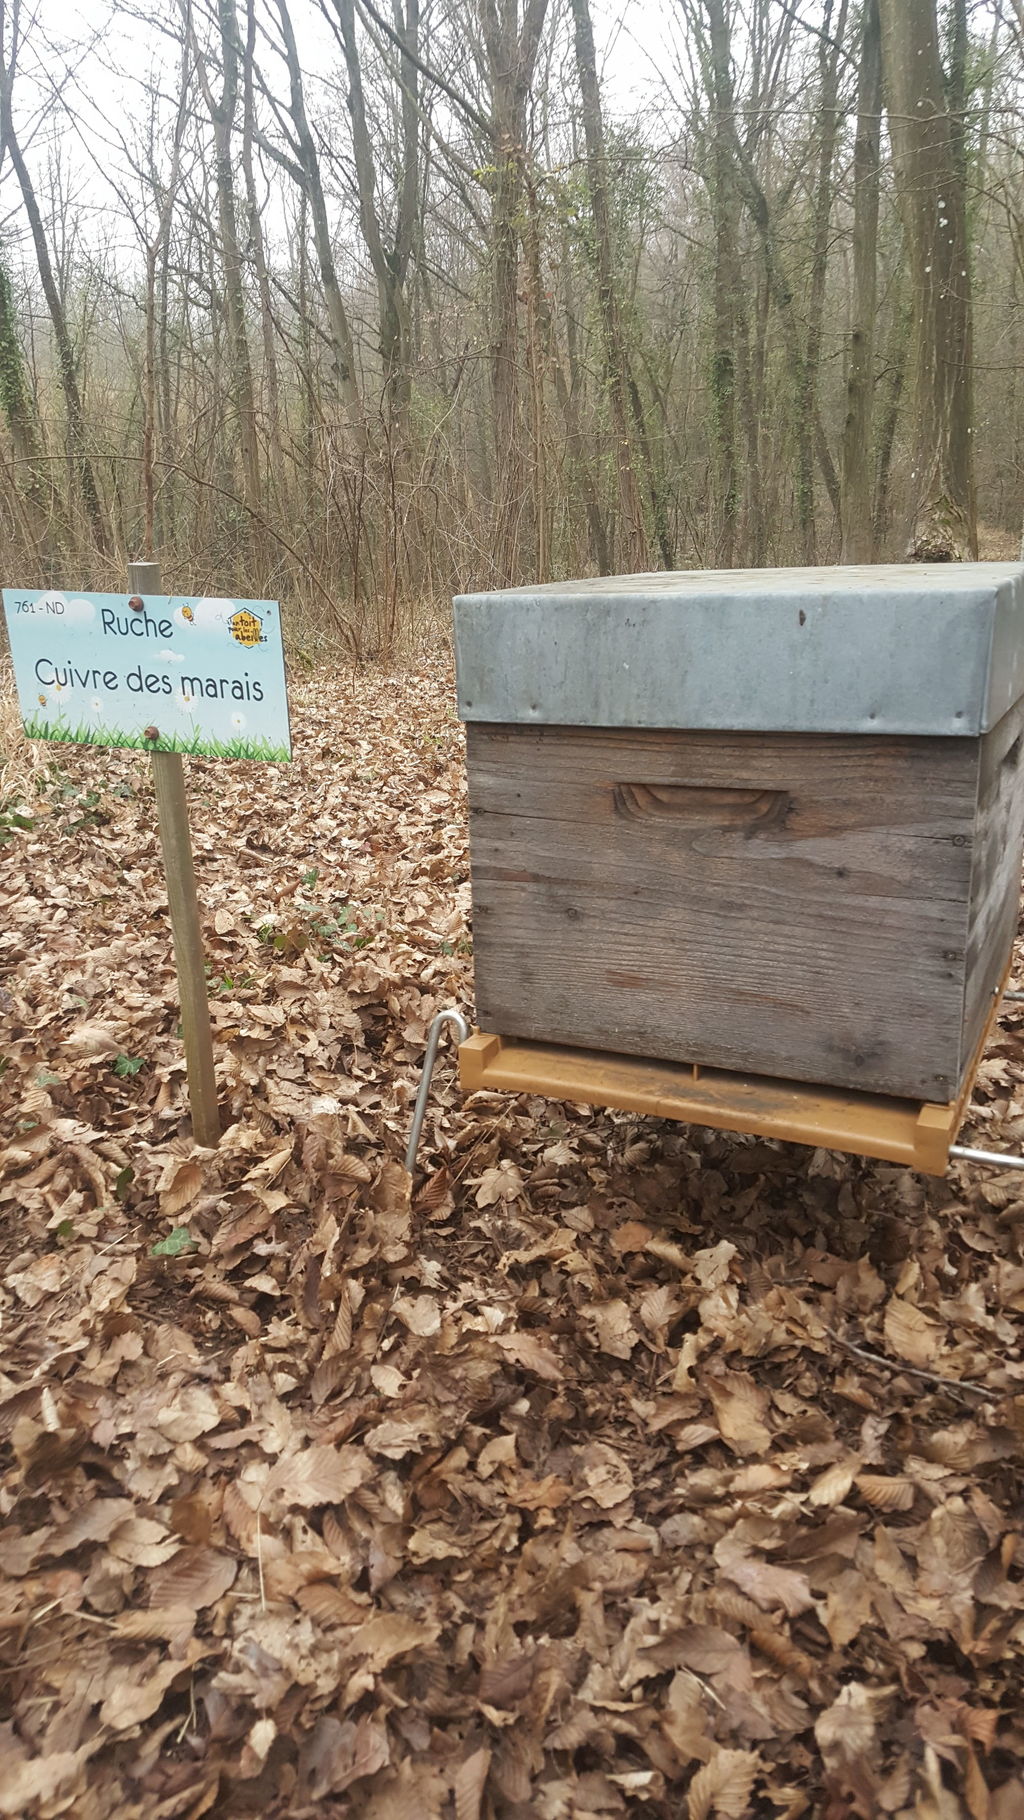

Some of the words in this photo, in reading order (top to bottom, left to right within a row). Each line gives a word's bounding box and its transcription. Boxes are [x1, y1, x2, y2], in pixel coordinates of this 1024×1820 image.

[14, 601, 36, 615] 761
[46, 601, 65, 615] ND
[101, 608, 174, 638] Ruche
[239, 615, 257, 627] toit
[235, 629, 268, 642] abeilles
[34, 658, 118, 690] Cuivre
[126, 665, 173, 695] des
[180, 672, 264, 702] marais
